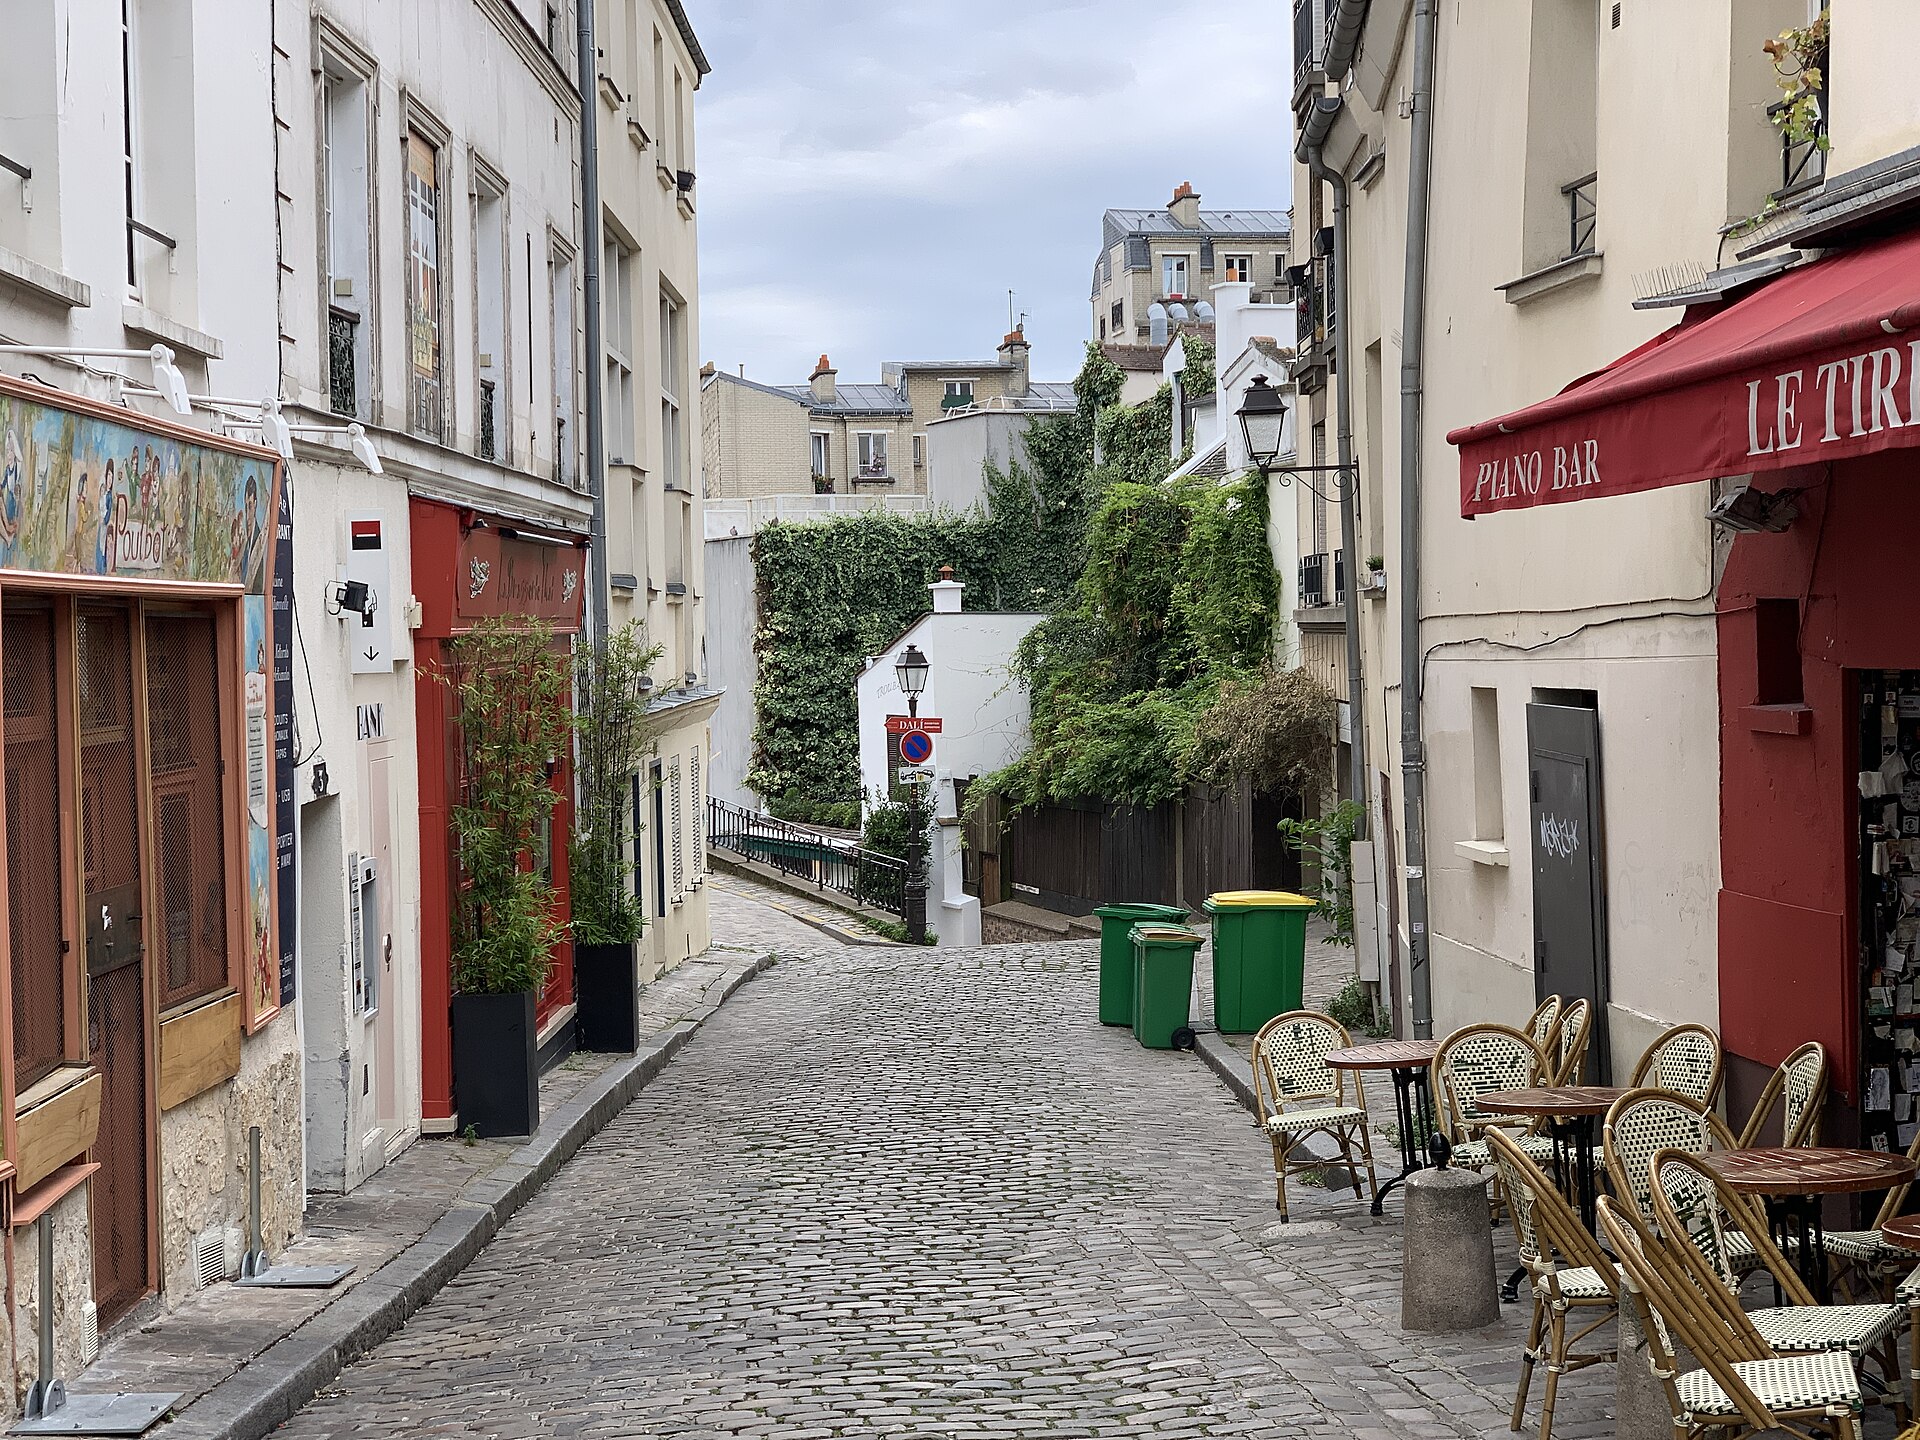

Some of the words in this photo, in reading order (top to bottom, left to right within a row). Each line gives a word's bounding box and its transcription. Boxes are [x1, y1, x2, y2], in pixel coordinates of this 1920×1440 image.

[1746, 370, 1803, 456] LE
[1472, 451, 1543, 502] PIANO
[1551, 439, 1601, 490] BAR
[276, 524, 291, 540] RANT
